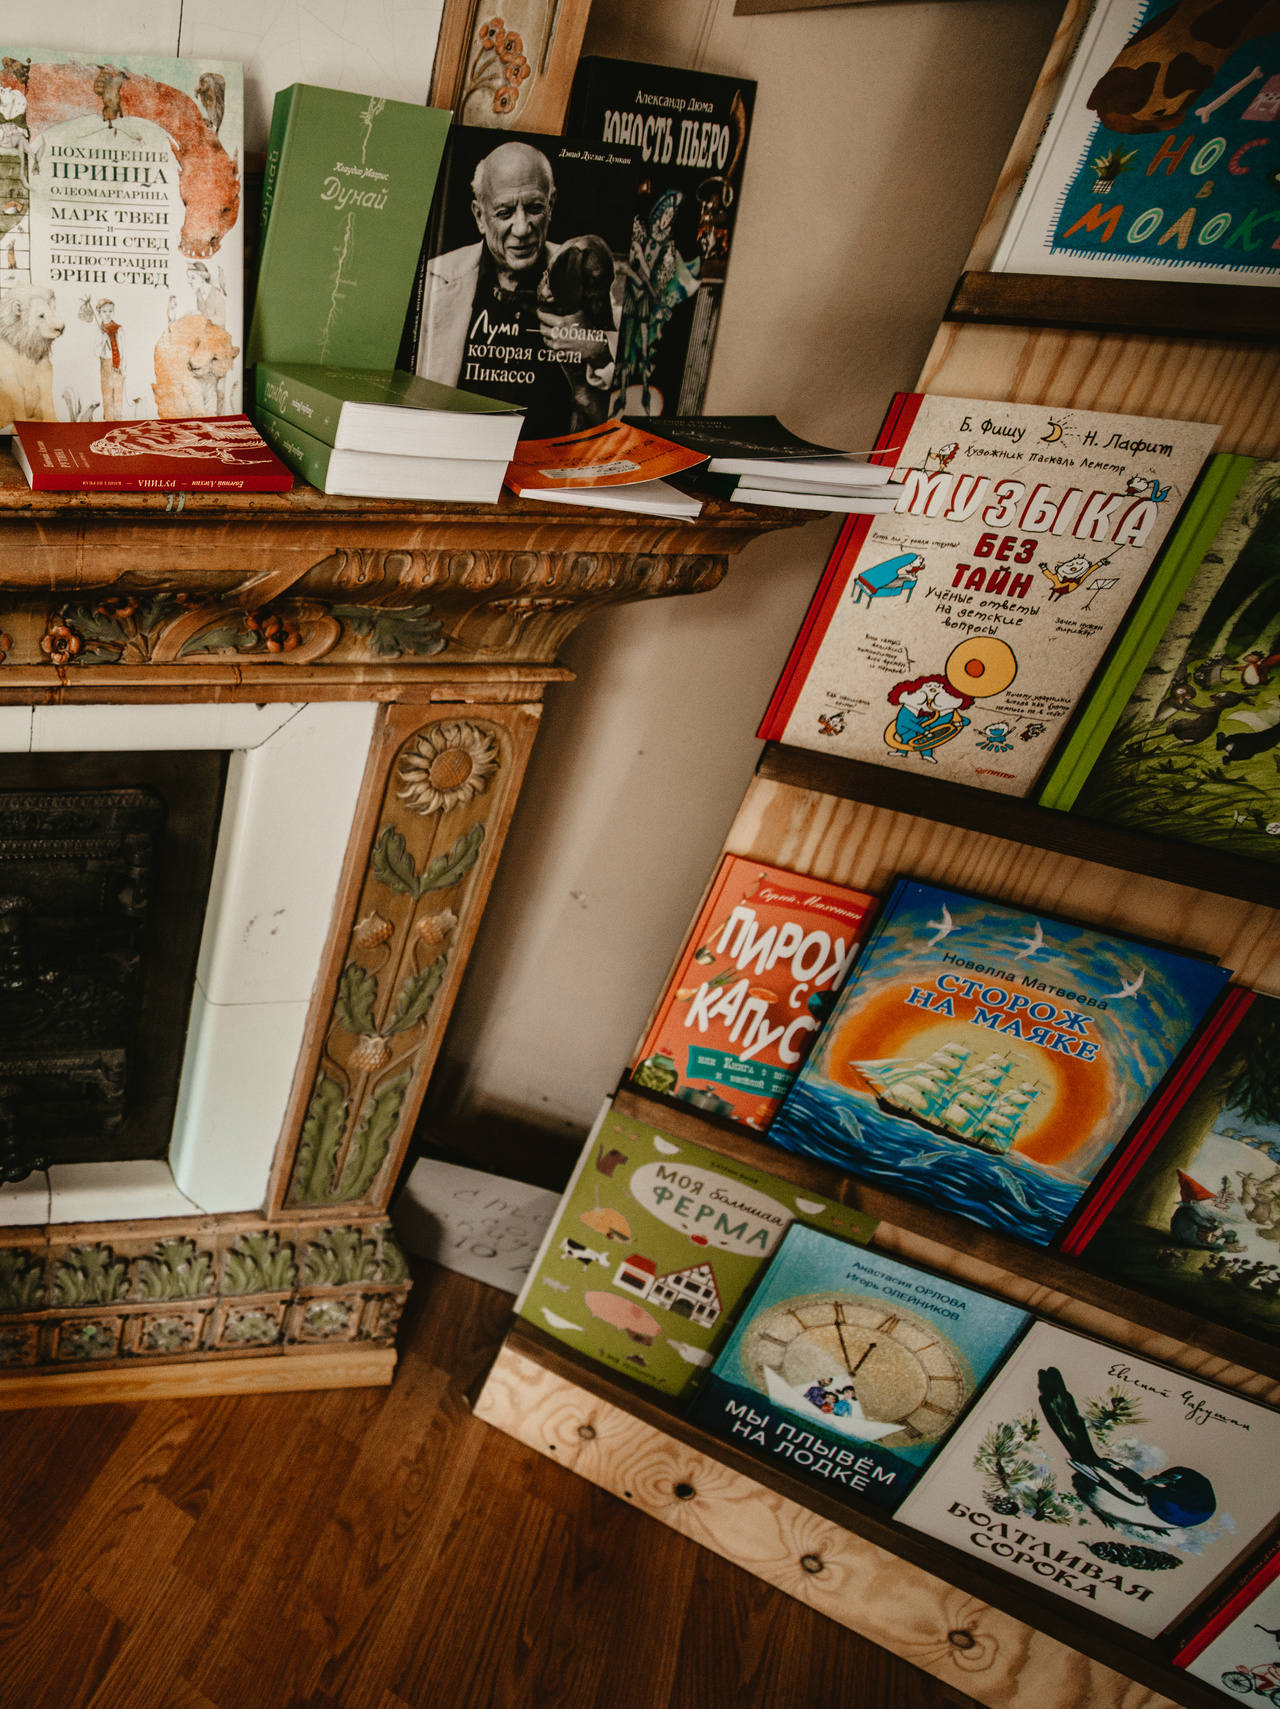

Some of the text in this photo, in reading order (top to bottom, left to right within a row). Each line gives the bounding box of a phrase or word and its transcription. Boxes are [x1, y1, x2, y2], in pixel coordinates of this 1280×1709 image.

[635, 90, 714, 113] Александр Дюма
[1039, 113, 1055, 137] НОС
[50, 145, 169, 164] ПОХИЩЕНИЕ
[558, 149, 632, 165] Дэвид Дуглас Дункан
[676, 119, 730, 170] ПЬЕРО
[1145, 134, 1270, 176] НОС
[50, 161, 169, 188] ПРИНЦА
[333, 162, 390, 181] Клаудио Магрис
[50, 185, 169, 200] ОЛЕОМАРГАРИНА
[320, 176, 390, 210] Дунай
[51, 207, 170, 225] МАРК ТВЕН
[50, 233, 170, 251] ФИЛИП СТЕД
[51, 254, 169, 270] ИЛЛЮСТРАЦИИ
[50, 268, 170, 289] ЭРИН СТЕД
[470, 308, 609, 345] Лумп собака,
[467, 343, 582, 364] которая съела
[465, 362, 536, 384] Пикассо
[959, 416, 1175, 458] Б. Фишу Н. Лафит
[964, 444, 1127, 475] Художник Паскаль Леметр
[138, 479, 244, 489] Евгений Алехин РУТИНА
[894, 467, 1160, 548] МУЗЫКА
[973, 532, 1039, 564] БЕЗ
[951, 563, 1035, 599] ТАЙН
[925, 586, 1041, 616] Учёные ответы
[941, 619, 999, 636] вопросы
[957, 608, 1024, 626] детские
[1055, 617, 1104, 632] Зачем нужен
[986, 769, 1016, 780] ПИТЕР
[759, 888, 862, 921] Сергей Махотин
[942, 952, 1109, 1011] Новелла Матвеева
[936, 973, 1095, 1036] СТОРОЖ
[904, 986, 1100, 1062] НА МАЯКЕ
[697, 1055, 717, 1067] или
[655, 1164, 784, 1227] МОЯ большая
[652, 1185, 771, 1251] ФЕРМА
[845, 1271, 961, 1321] Игорь ОЛЕЙНИКОВ
[852, 1261, 967, 1311] Анастасия ОРЛОВА
[1107, 1362, 1251, 1432] Евгений Чарушин
[724, 1399, 898, 1486] МЫ ПЛЫВЁМ
[731, 1420, 871, 1492] НА ЛОДКЕ
[946, 1501, 1155, 1603] БОЛТЛИВАЯ
[969, 1532, 1098, 1601] СОРОКА
